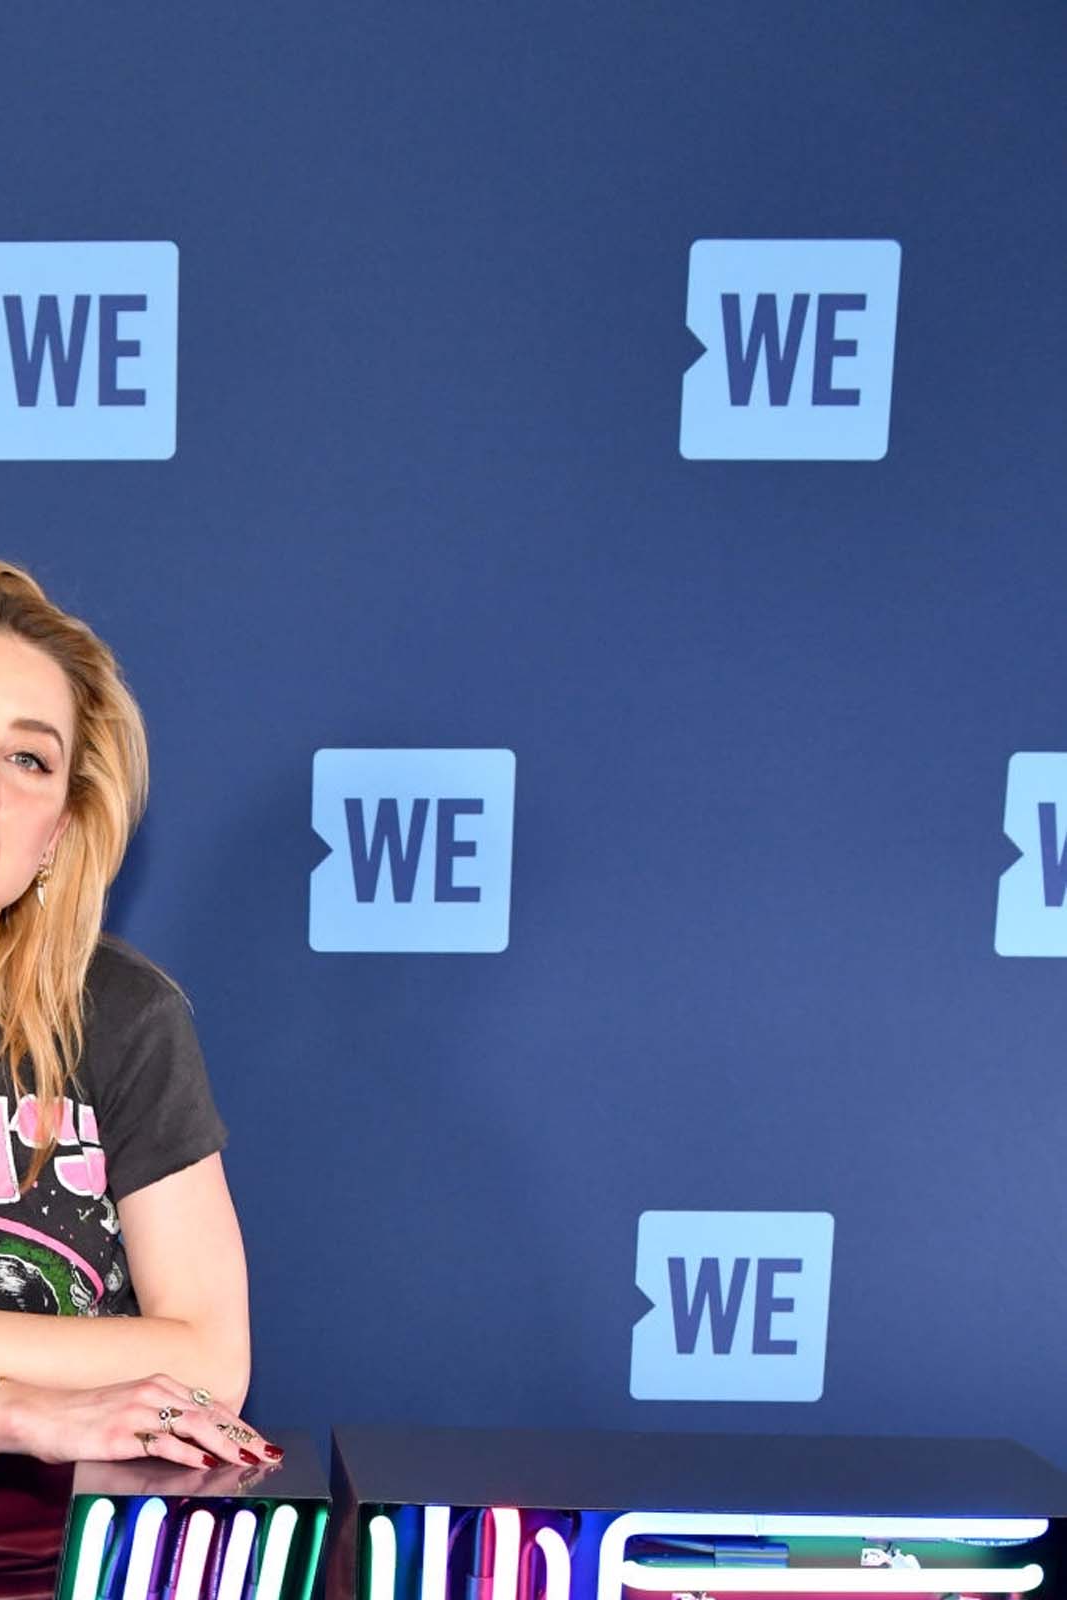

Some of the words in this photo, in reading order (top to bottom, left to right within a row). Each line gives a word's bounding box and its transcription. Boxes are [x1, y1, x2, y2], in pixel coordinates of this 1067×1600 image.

[3, 294, 148, 407] WE
[721, 293, 867, 407] WE
[344, 798, 484, 903] WE
[668, 1257, 803, 1355] WE
